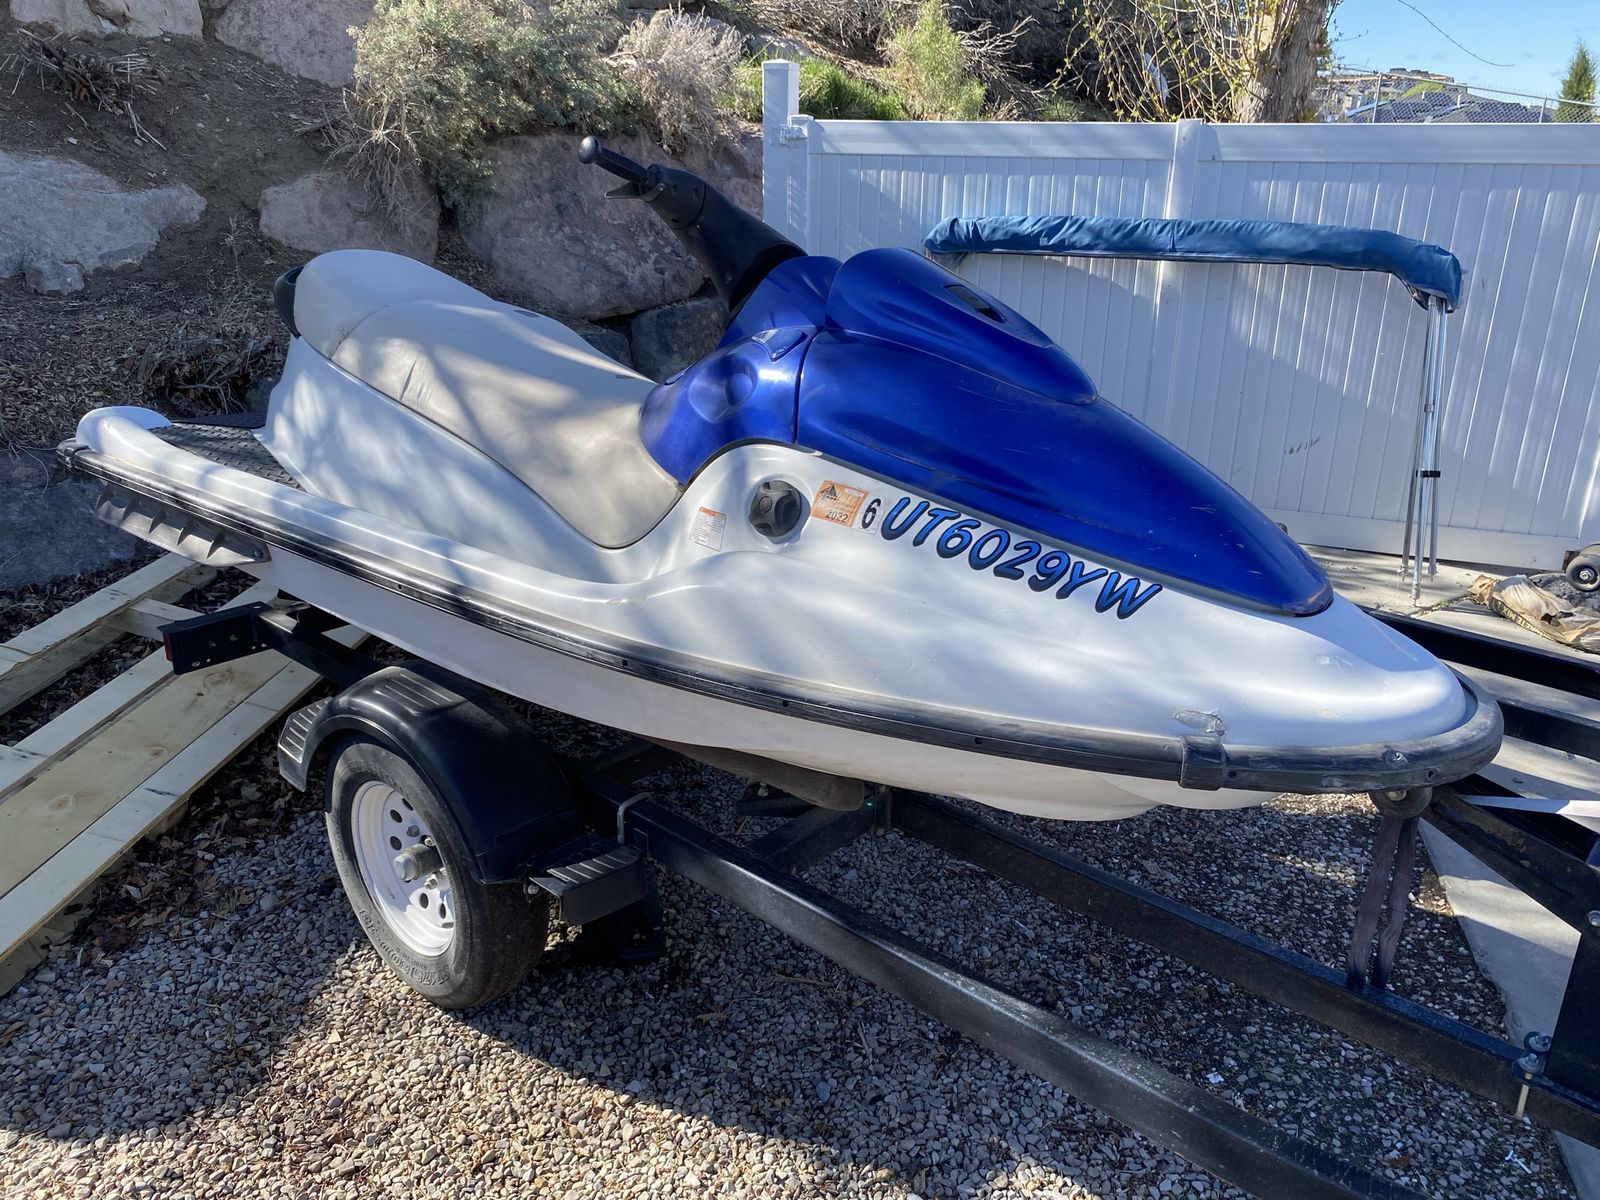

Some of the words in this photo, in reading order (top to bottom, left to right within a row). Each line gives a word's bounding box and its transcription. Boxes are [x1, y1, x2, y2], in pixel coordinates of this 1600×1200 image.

[824, 508, 849, 524] 2022
[861, 498, 881, 529] 6
[880, 496, 1163, 620] UT6029YW
